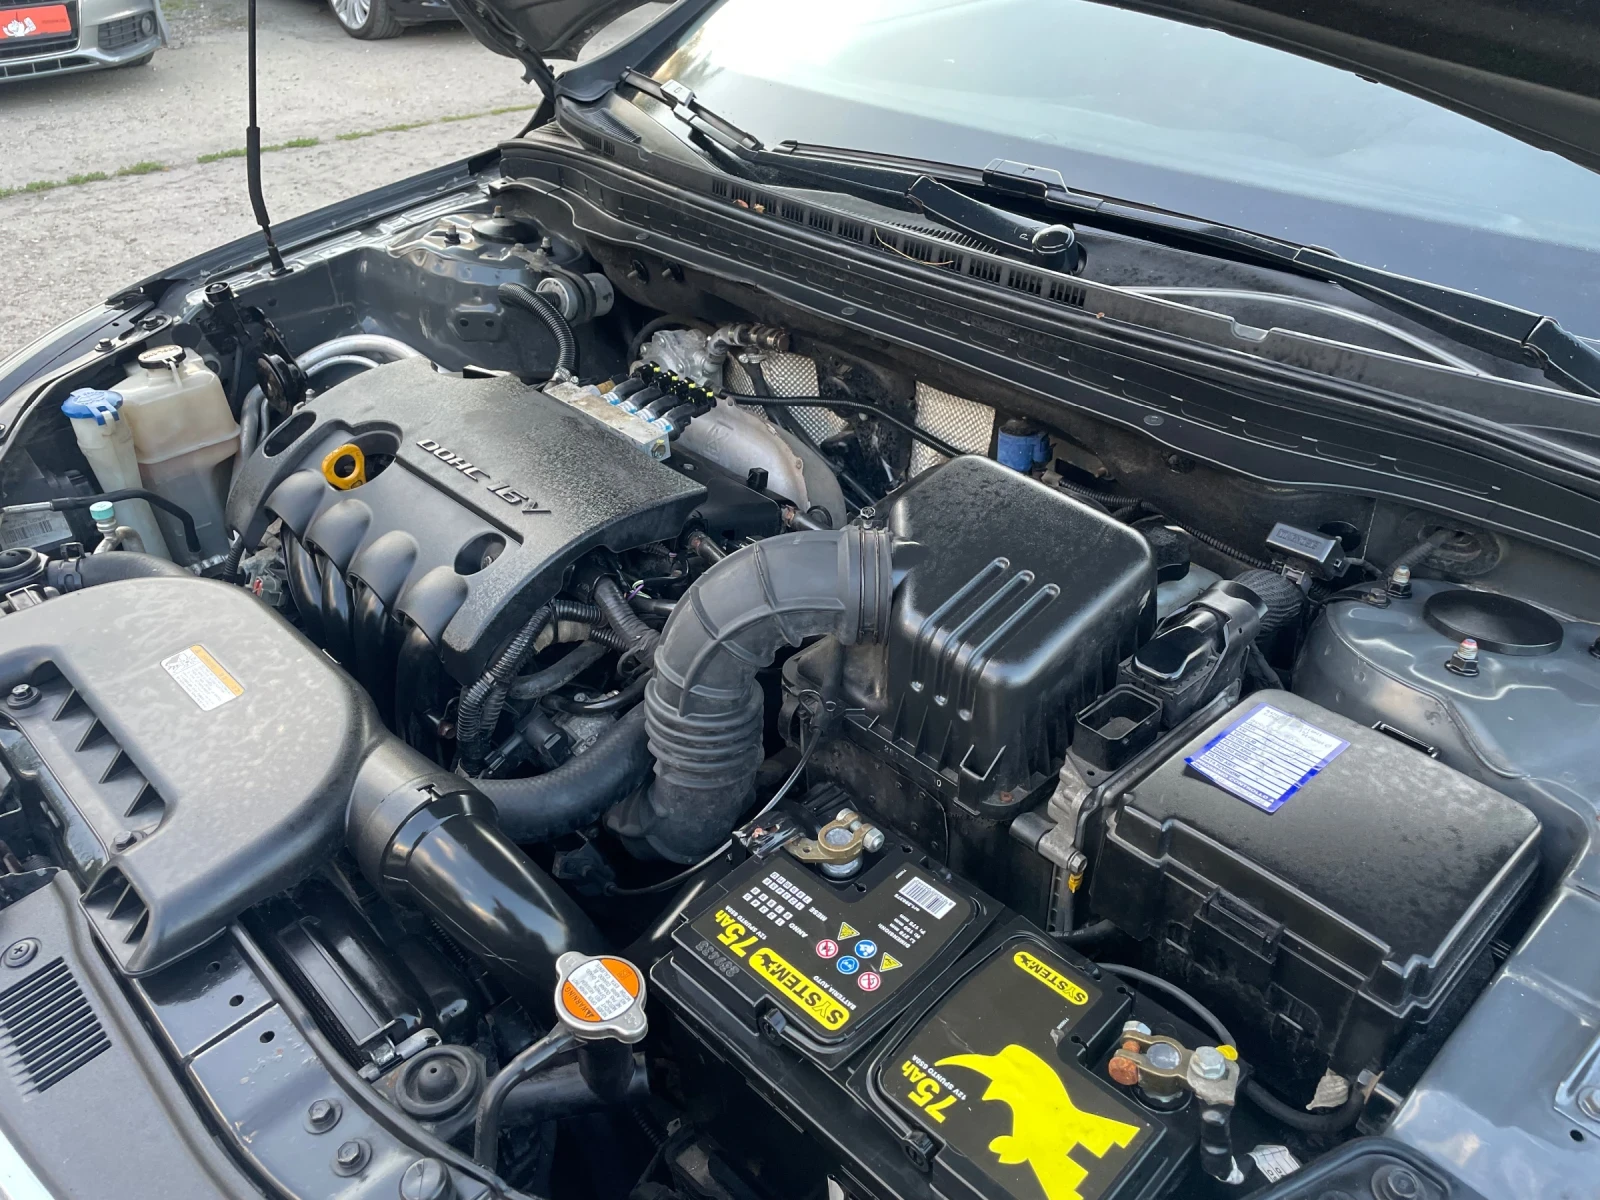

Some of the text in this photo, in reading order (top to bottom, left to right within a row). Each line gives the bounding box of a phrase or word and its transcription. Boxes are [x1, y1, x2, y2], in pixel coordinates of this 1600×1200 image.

[415, 438, 551, 513] DOHC 16V
[1228, 777, 1268, 799] CONTROLLO
[736, 914, 758, 932] SPUNTO
[808, 906, 827, 921] MESE
[787, 922, 808, 938] ANNO
[564, 986, 588, 1012] WARNING
[812, 974, 856, 1010] BATTERIA AUTO
[926, 1065, 954, 1090] SPUNTO
[952, 1086, 967, 1101] 12V
